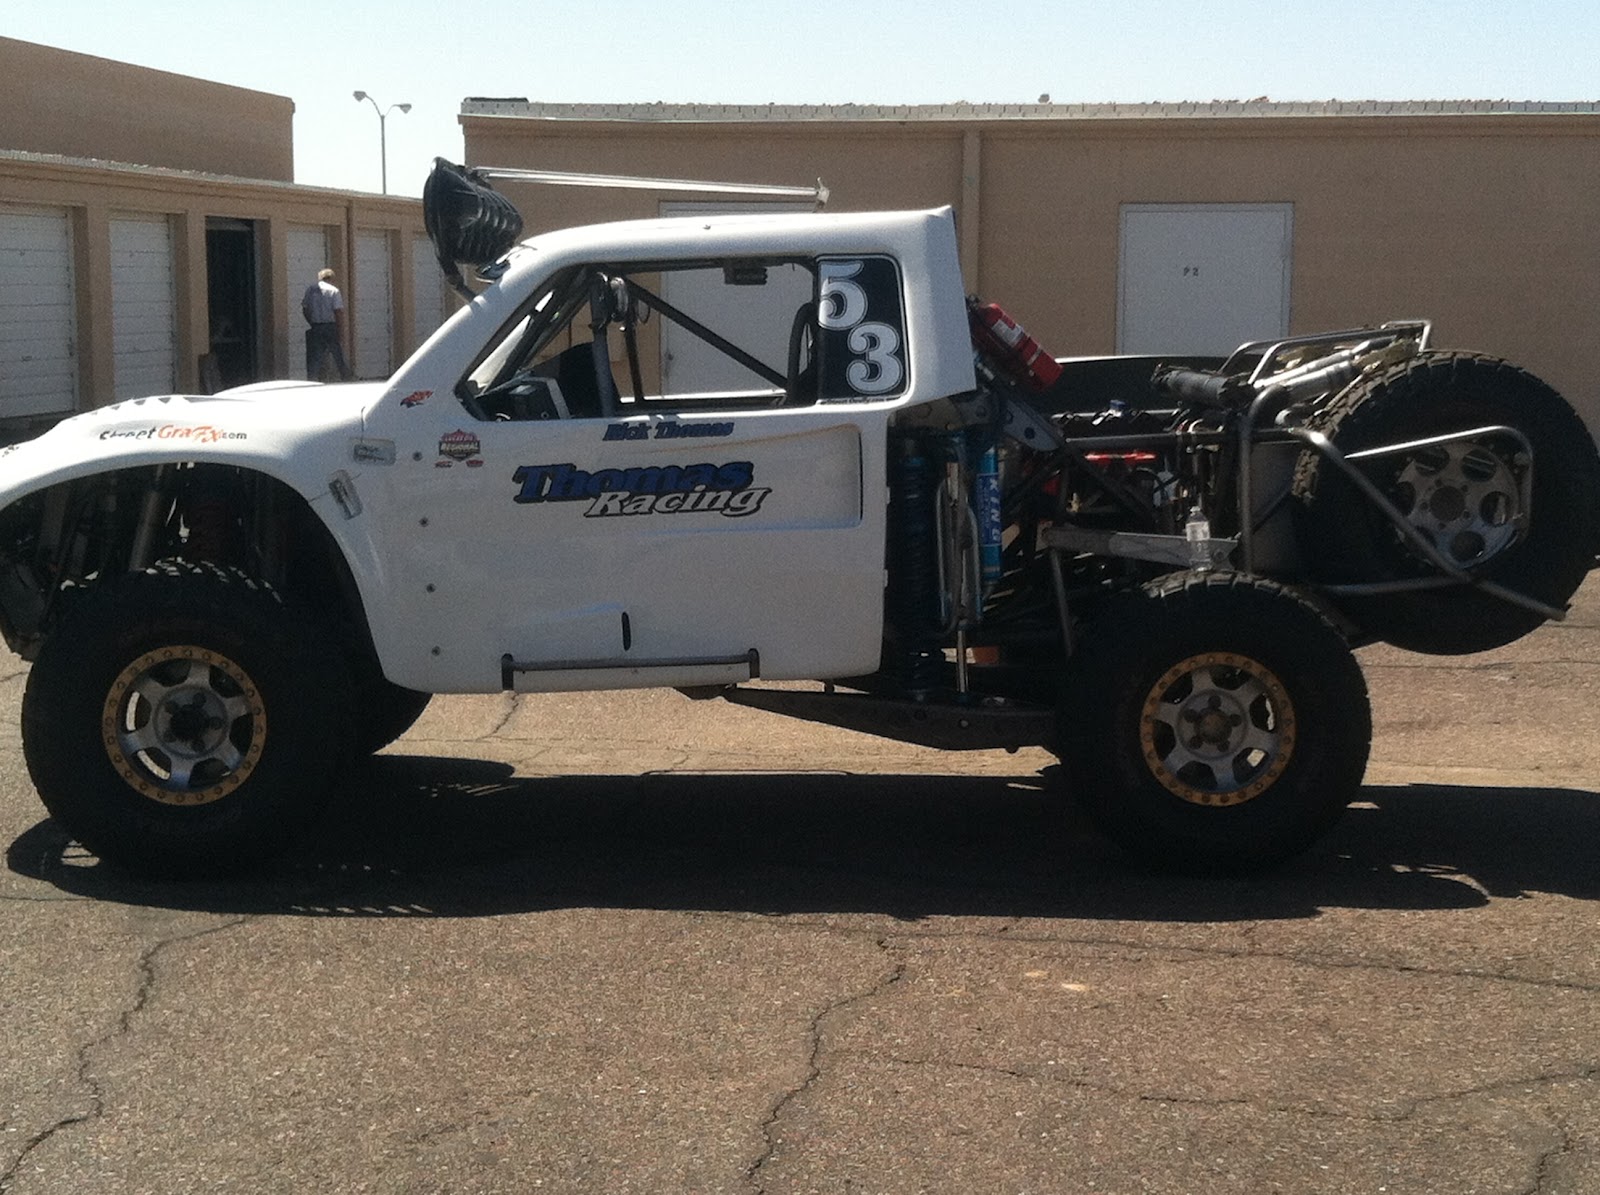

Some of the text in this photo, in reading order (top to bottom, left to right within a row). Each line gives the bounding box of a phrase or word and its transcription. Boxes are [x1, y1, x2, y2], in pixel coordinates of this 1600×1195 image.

[602, 420, 735, 441] Rick Thomas
[512, 461, 754, 503] Thomas
[583, 485, 772, 518] Racing
